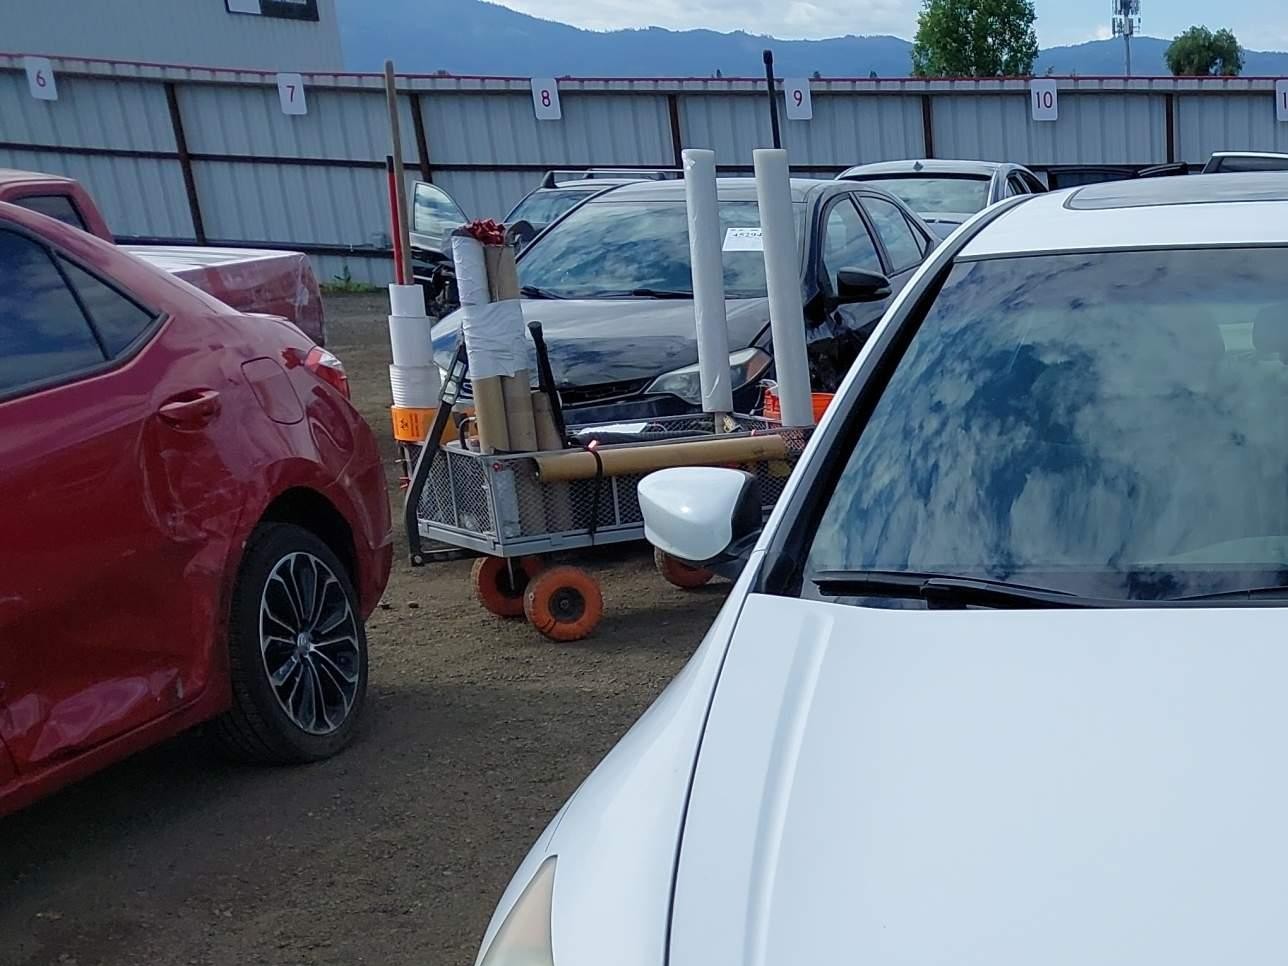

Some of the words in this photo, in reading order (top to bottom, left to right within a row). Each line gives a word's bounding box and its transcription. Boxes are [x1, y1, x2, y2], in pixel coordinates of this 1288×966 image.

[36, 70, 46, 88] 6
[286, 85, 296, 103] 7
[541, 89, 551, 107] 8
[793, 90, 803, 107] 9
[1036, 91, 1053, 109] 10
